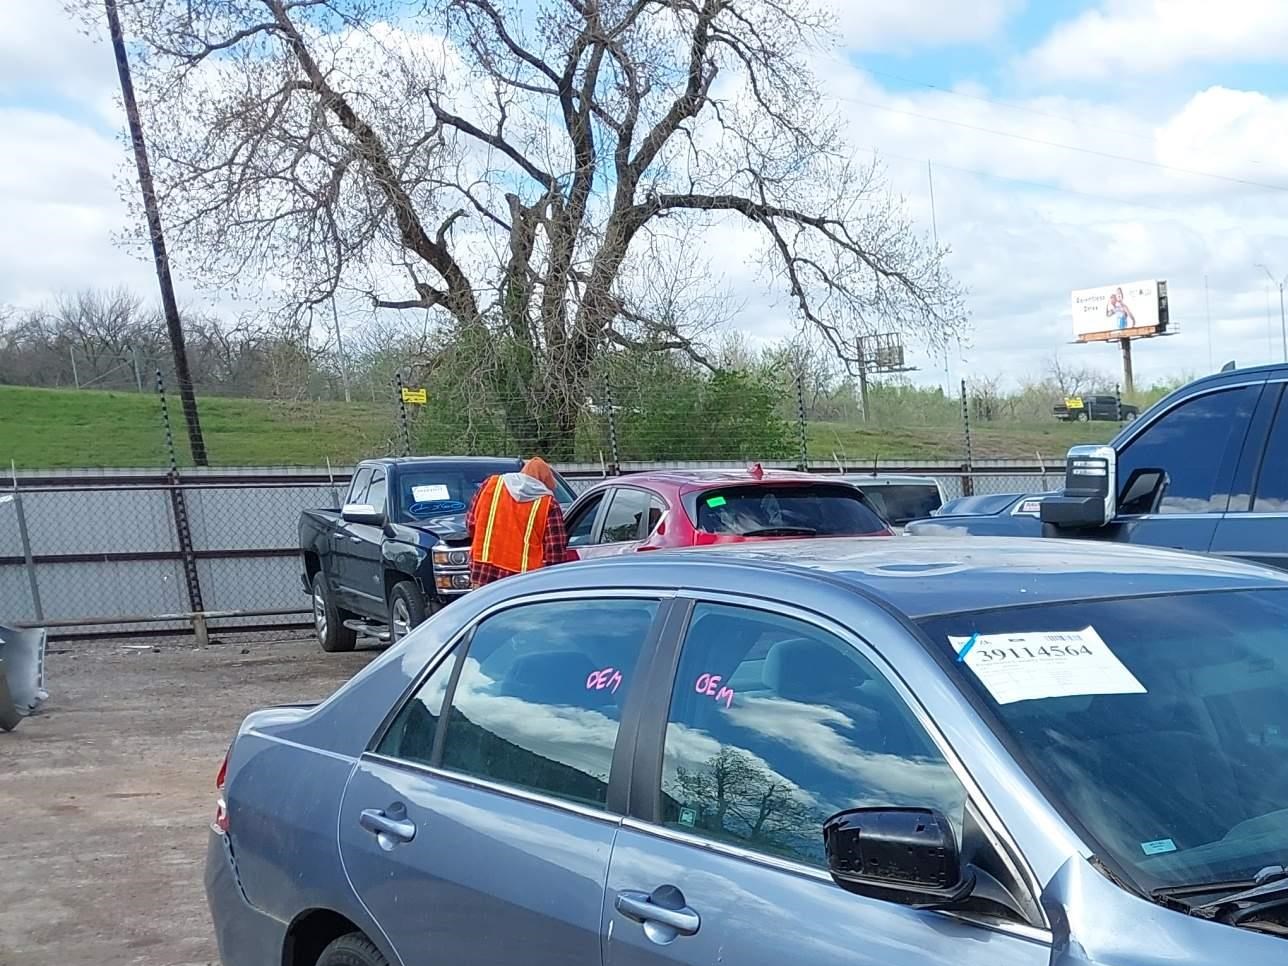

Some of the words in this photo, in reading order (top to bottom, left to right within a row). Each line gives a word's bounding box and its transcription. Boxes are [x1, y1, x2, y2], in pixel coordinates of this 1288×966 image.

[976, 644, 1094, 662] 39114564
[586, 667, 624, 695] OEM
[695, 673, 734, 709] OEM
